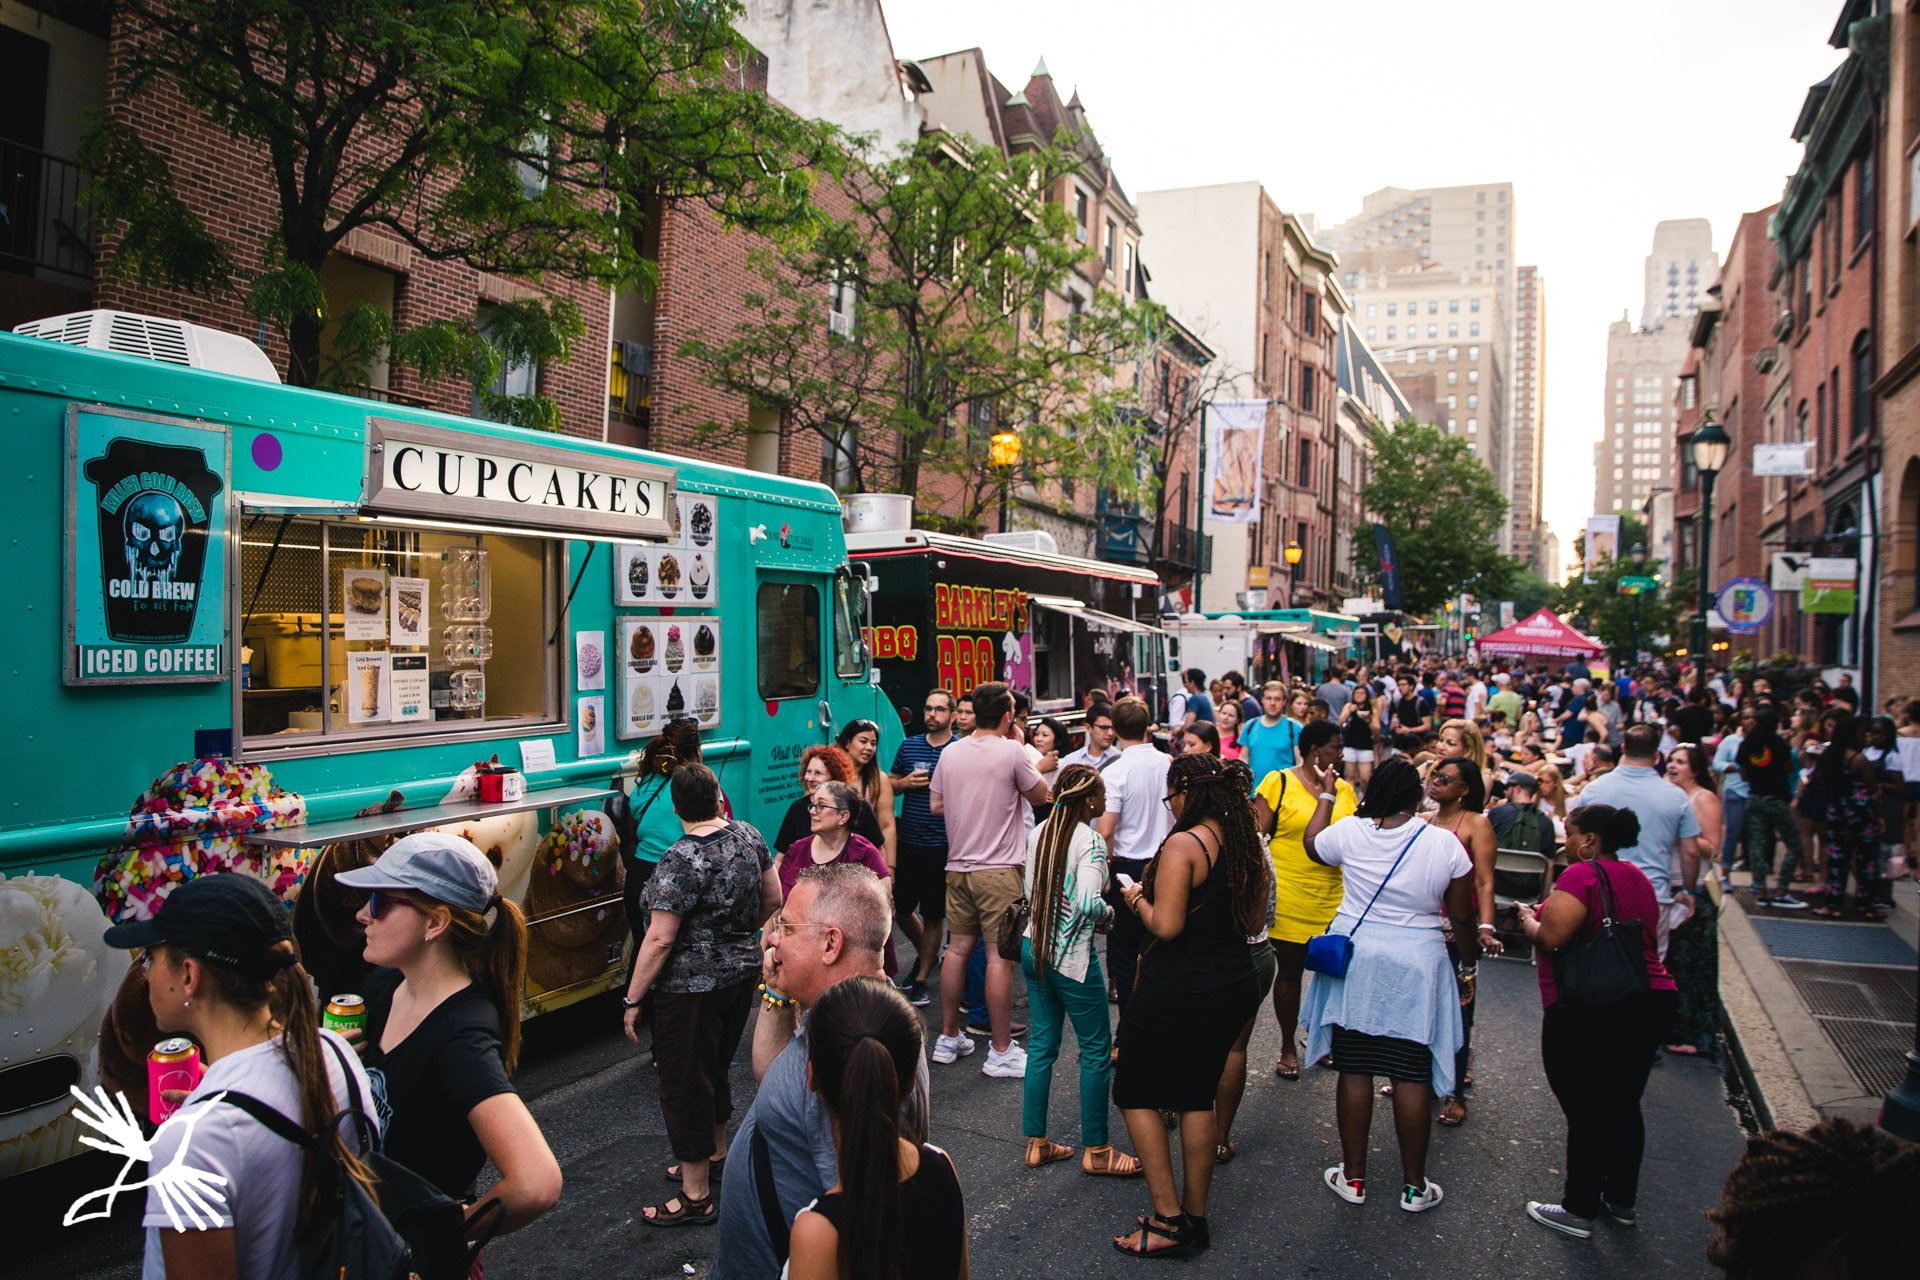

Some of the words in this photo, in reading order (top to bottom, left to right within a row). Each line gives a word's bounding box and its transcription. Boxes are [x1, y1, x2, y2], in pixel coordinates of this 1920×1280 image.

[101, 474, 142, 515] KILLER
[140, 471, 176, 494] COLD
[173, 481, 207, 524] BREW
[393, 447, 651, 516] CUPCAKES
[109, 579, 149, 598] COLD
[152, 580, 195, 600] BREW
[935, 583, 1030, 633] BARKLEY'S
[87, 649, 137, 673] ICED
[144, 648, 215, 672] COFFEE
[861, 625, 918, 661] BBQ
[936, 635, 995, 700] BBQ
[771, 744, 790, 761] Visit
